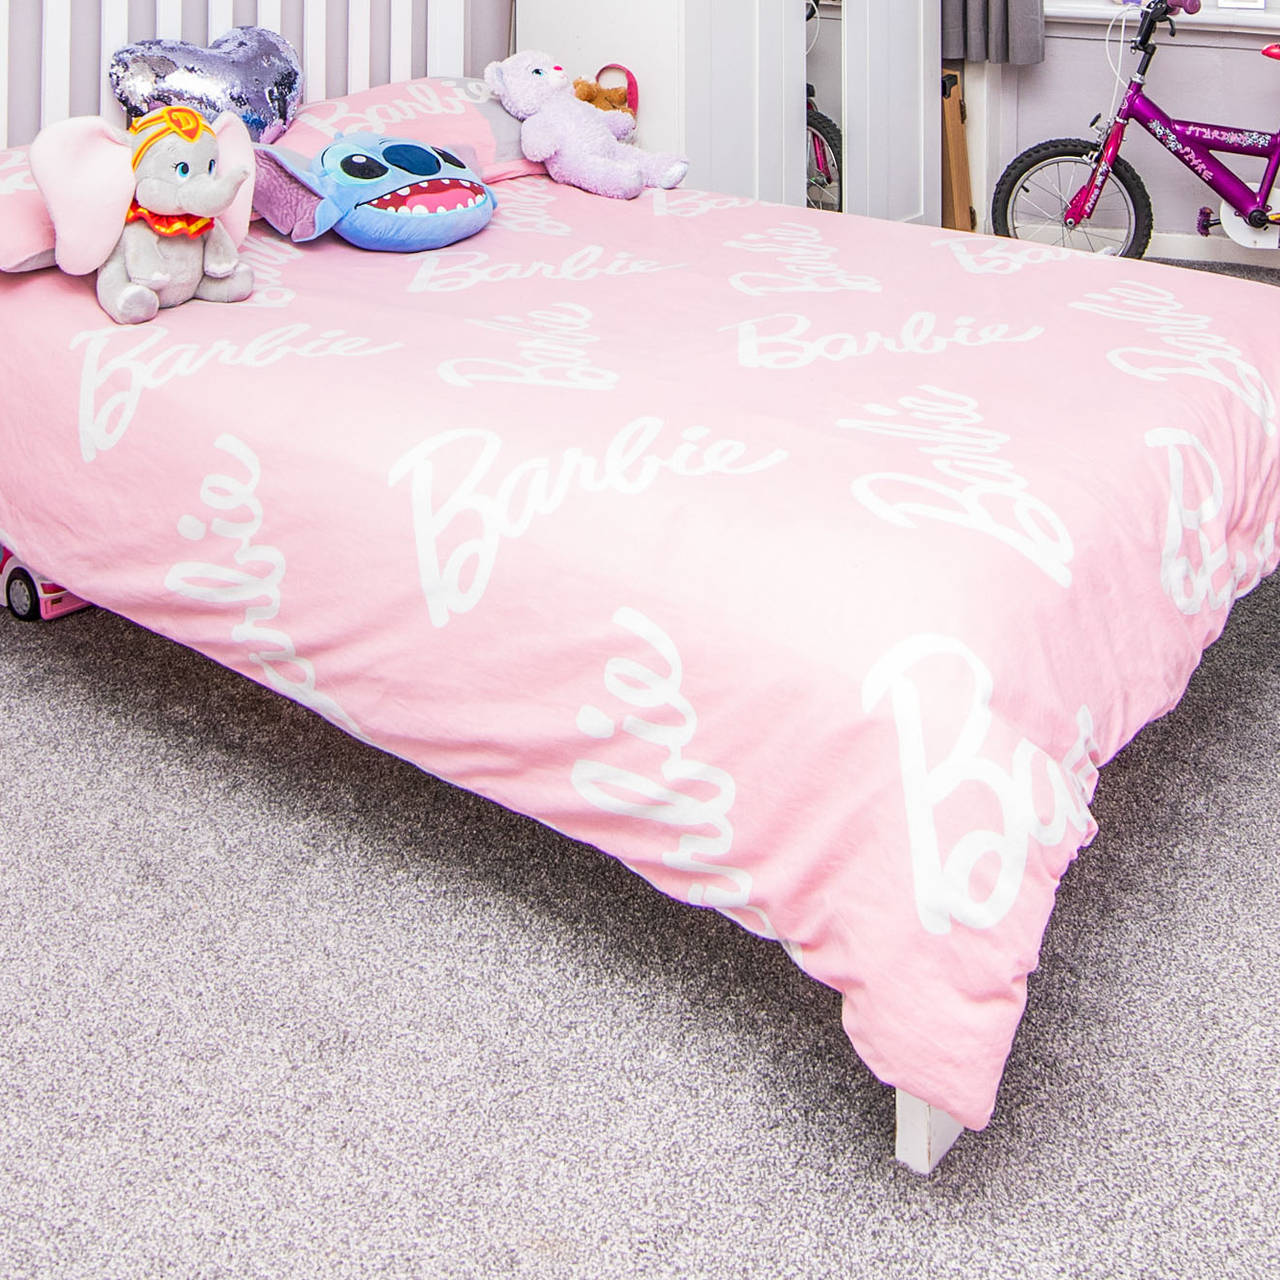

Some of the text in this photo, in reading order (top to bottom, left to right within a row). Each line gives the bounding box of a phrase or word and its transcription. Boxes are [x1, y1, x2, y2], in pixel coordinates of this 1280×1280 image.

[406, 245, 689, 293] Barbie
[723, 222, 883, 297] Barbie
[69, 323, 405, 463] Barbie
[437, 302, 619, 390] Barbie
[716, 311, 1045, 369] Barbie
[1069, 280, 1277, 437] Barbie
[388, 416, 789, 628] Barbie
[835, 385, 1074, 588] Barbie
